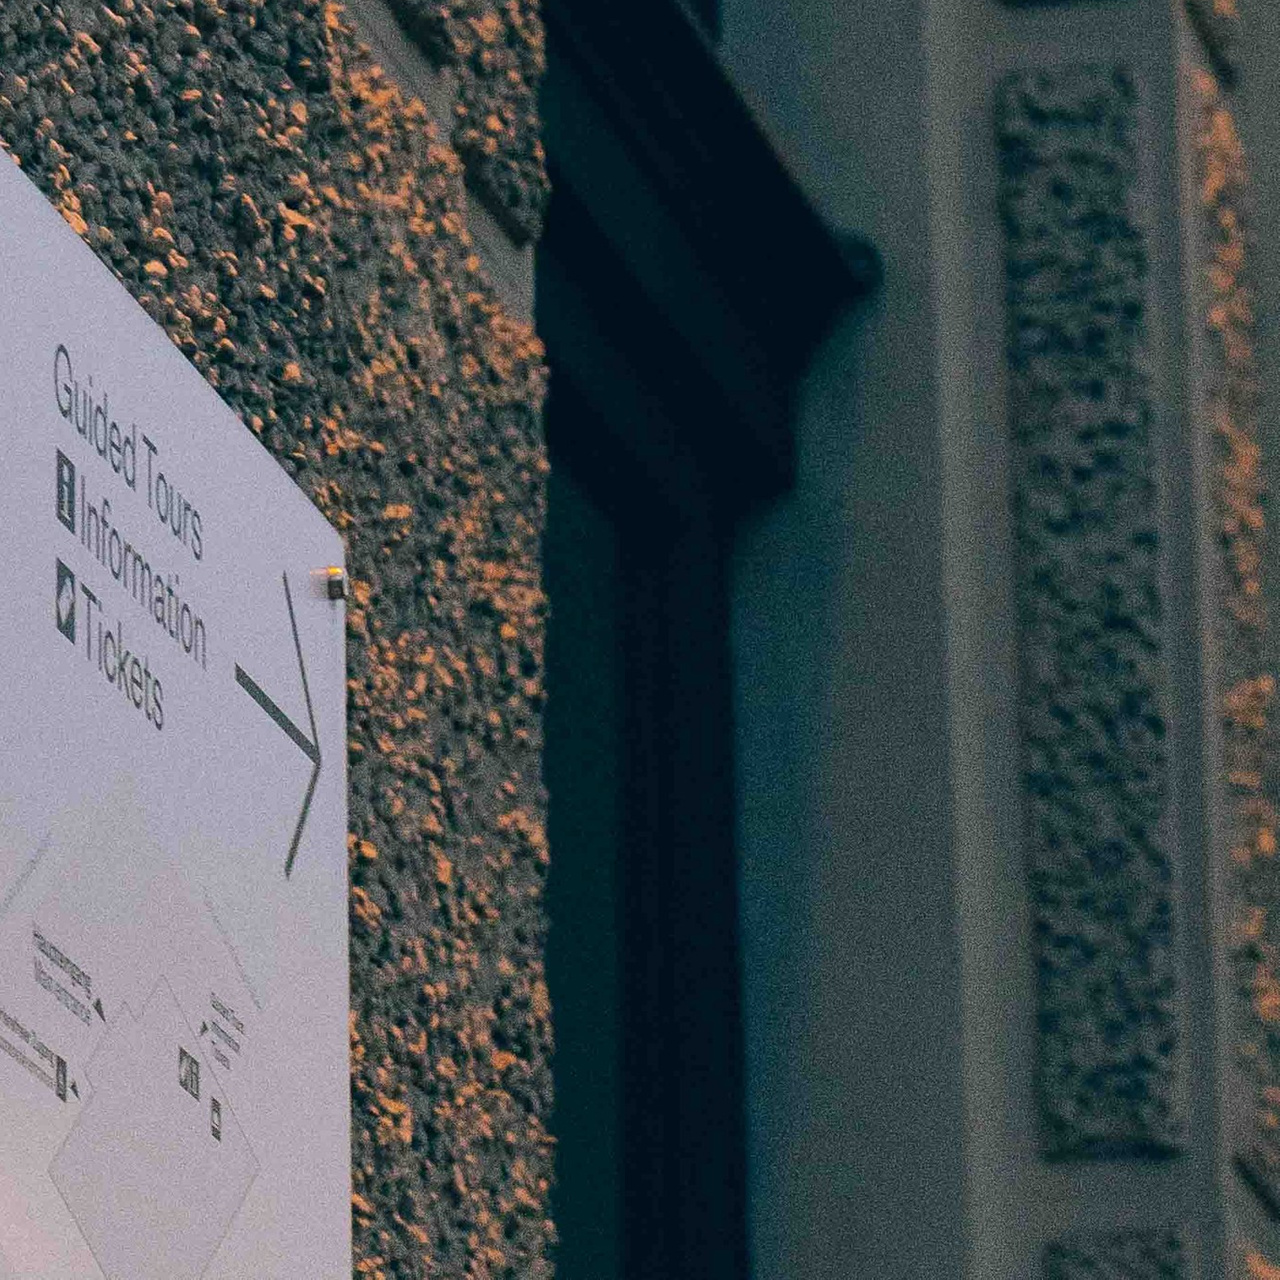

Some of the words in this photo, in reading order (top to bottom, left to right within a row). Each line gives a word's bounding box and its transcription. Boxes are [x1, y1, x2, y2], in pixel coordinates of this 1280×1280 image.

[53, 343, 137, 492] Guided
[142, 434, 204, 561] Tours
[80, 581, 165, 731] Tickets
[81, 475, 207, 671] Information
